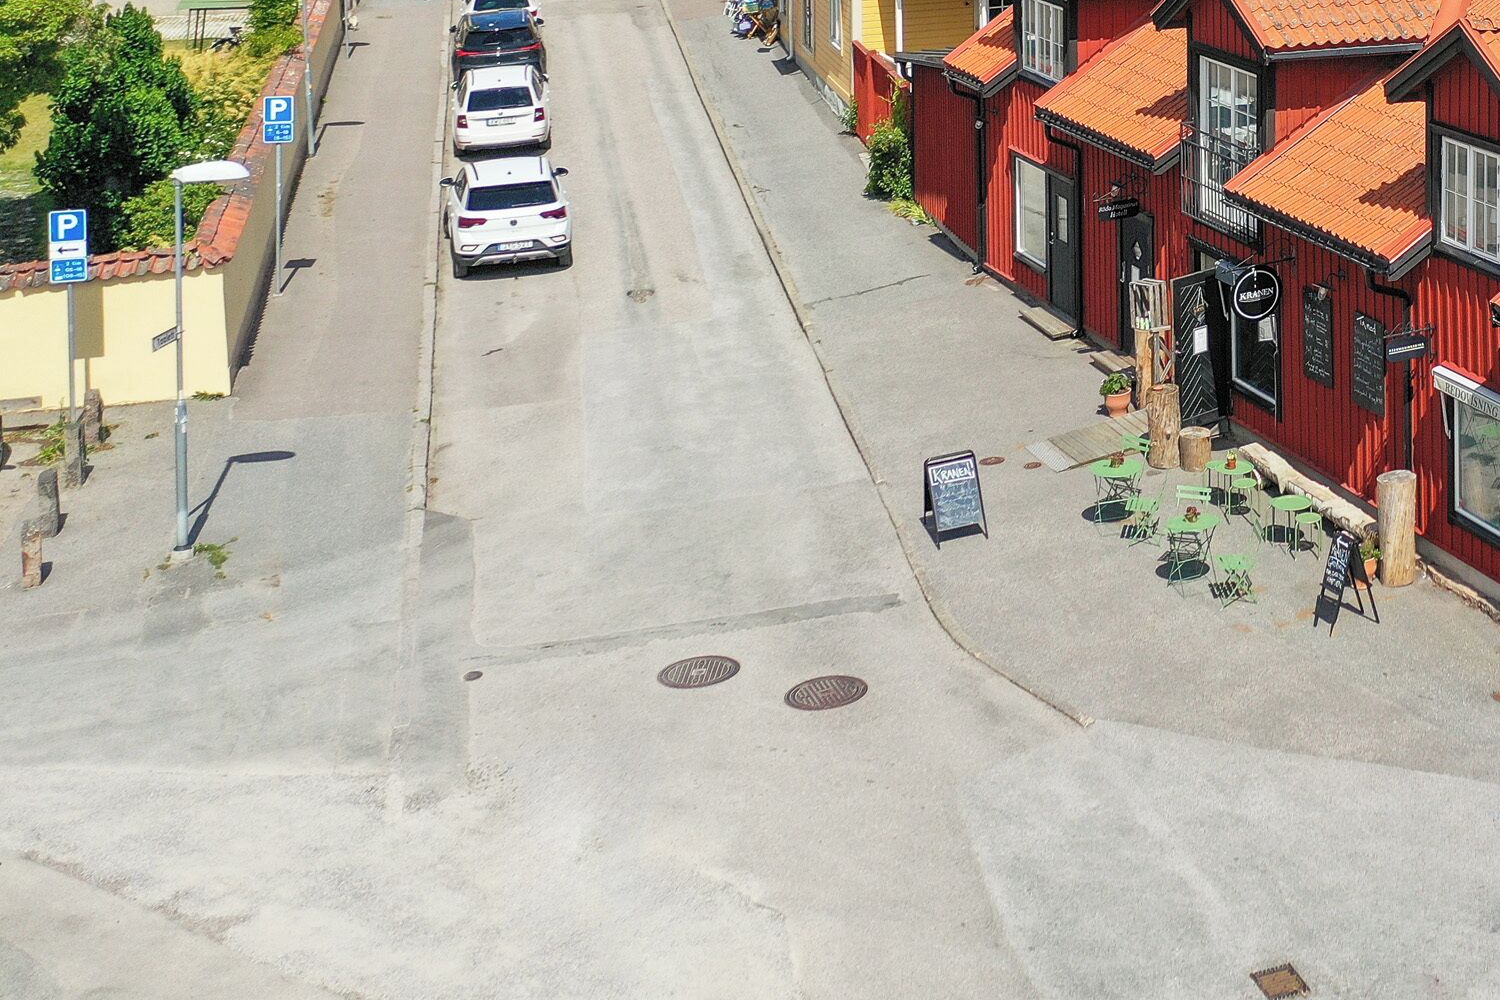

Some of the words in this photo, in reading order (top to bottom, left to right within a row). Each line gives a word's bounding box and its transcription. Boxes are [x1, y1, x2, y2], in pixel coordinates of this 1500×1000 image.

[270, 99, 288, 121] P
[58, 214, 78, 239] P
[1239, 287, 1274, 301] KRANEN
[1444, 382, 1499, 418] REDOVISNING
